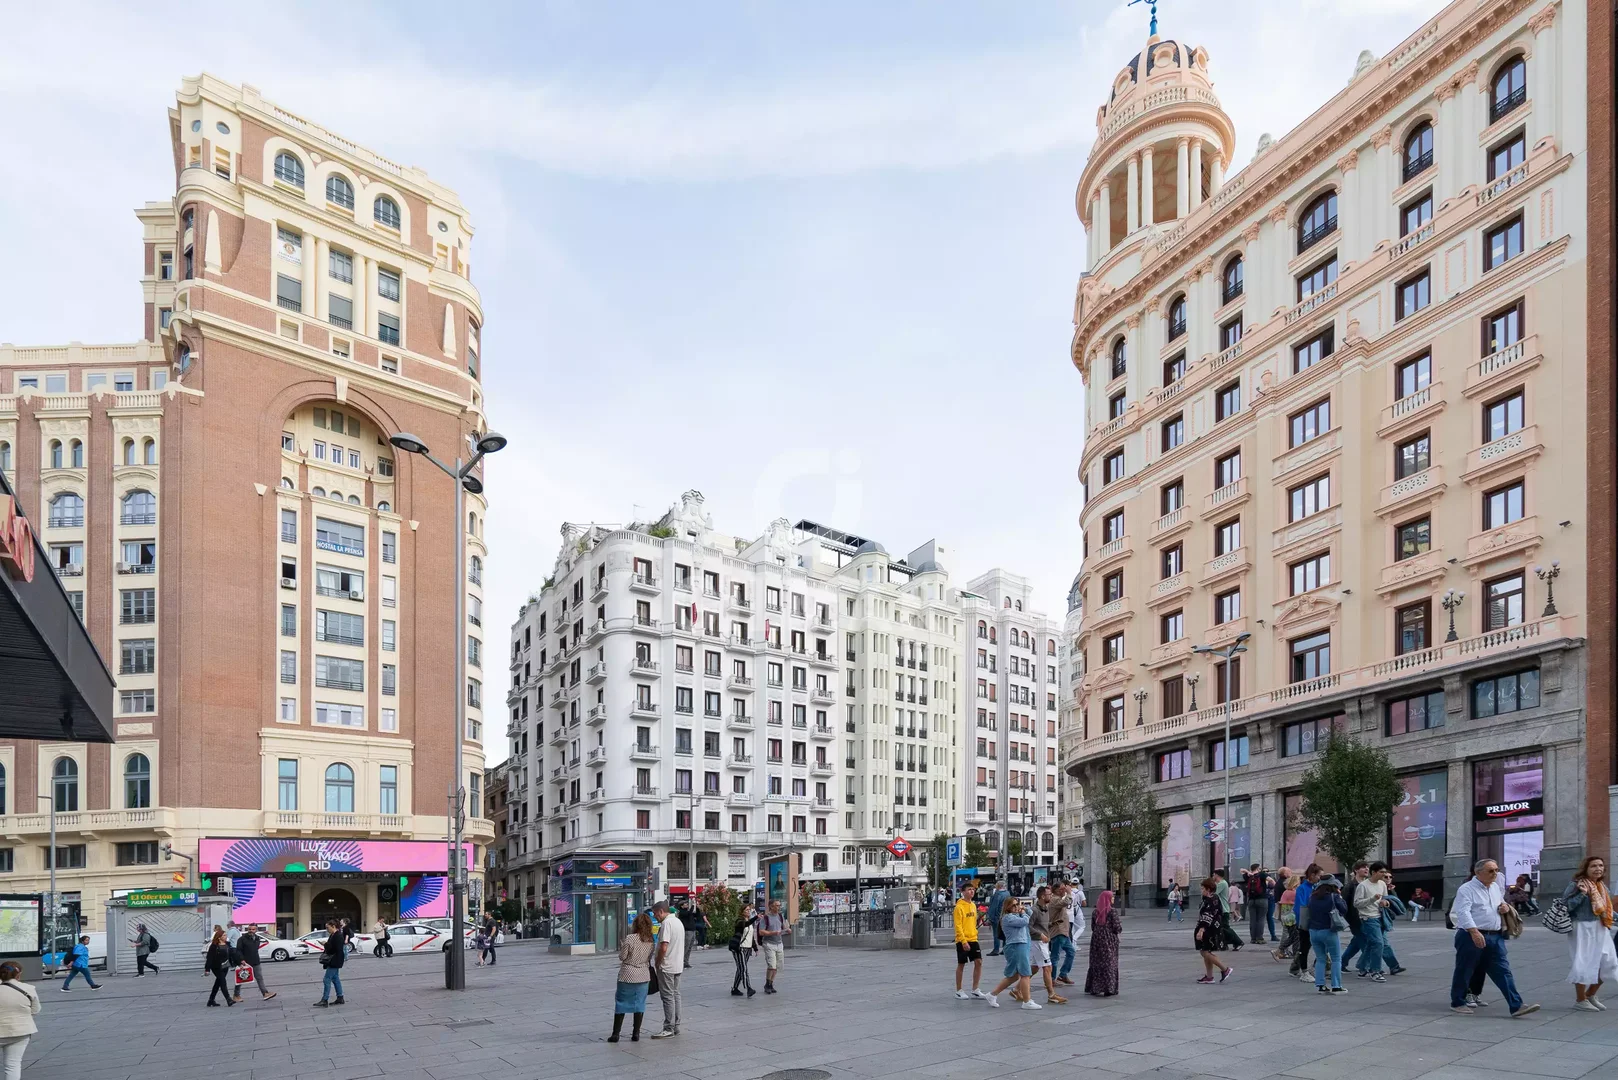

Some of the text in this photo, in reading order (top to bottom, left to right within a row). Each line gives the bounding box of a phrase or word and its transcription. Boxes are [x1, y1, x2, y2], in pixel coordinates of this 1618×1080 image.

[316, 540, 364, 556] HOSTAL LA PRENSA
[1486, 801, 1530, 814] PRIMOR
[300, 842, 328, 852] LUZ
[949, 845, 956, 859] P
[318, 852, 350, 861] MAD
[309, 860, 331, 870] RID
